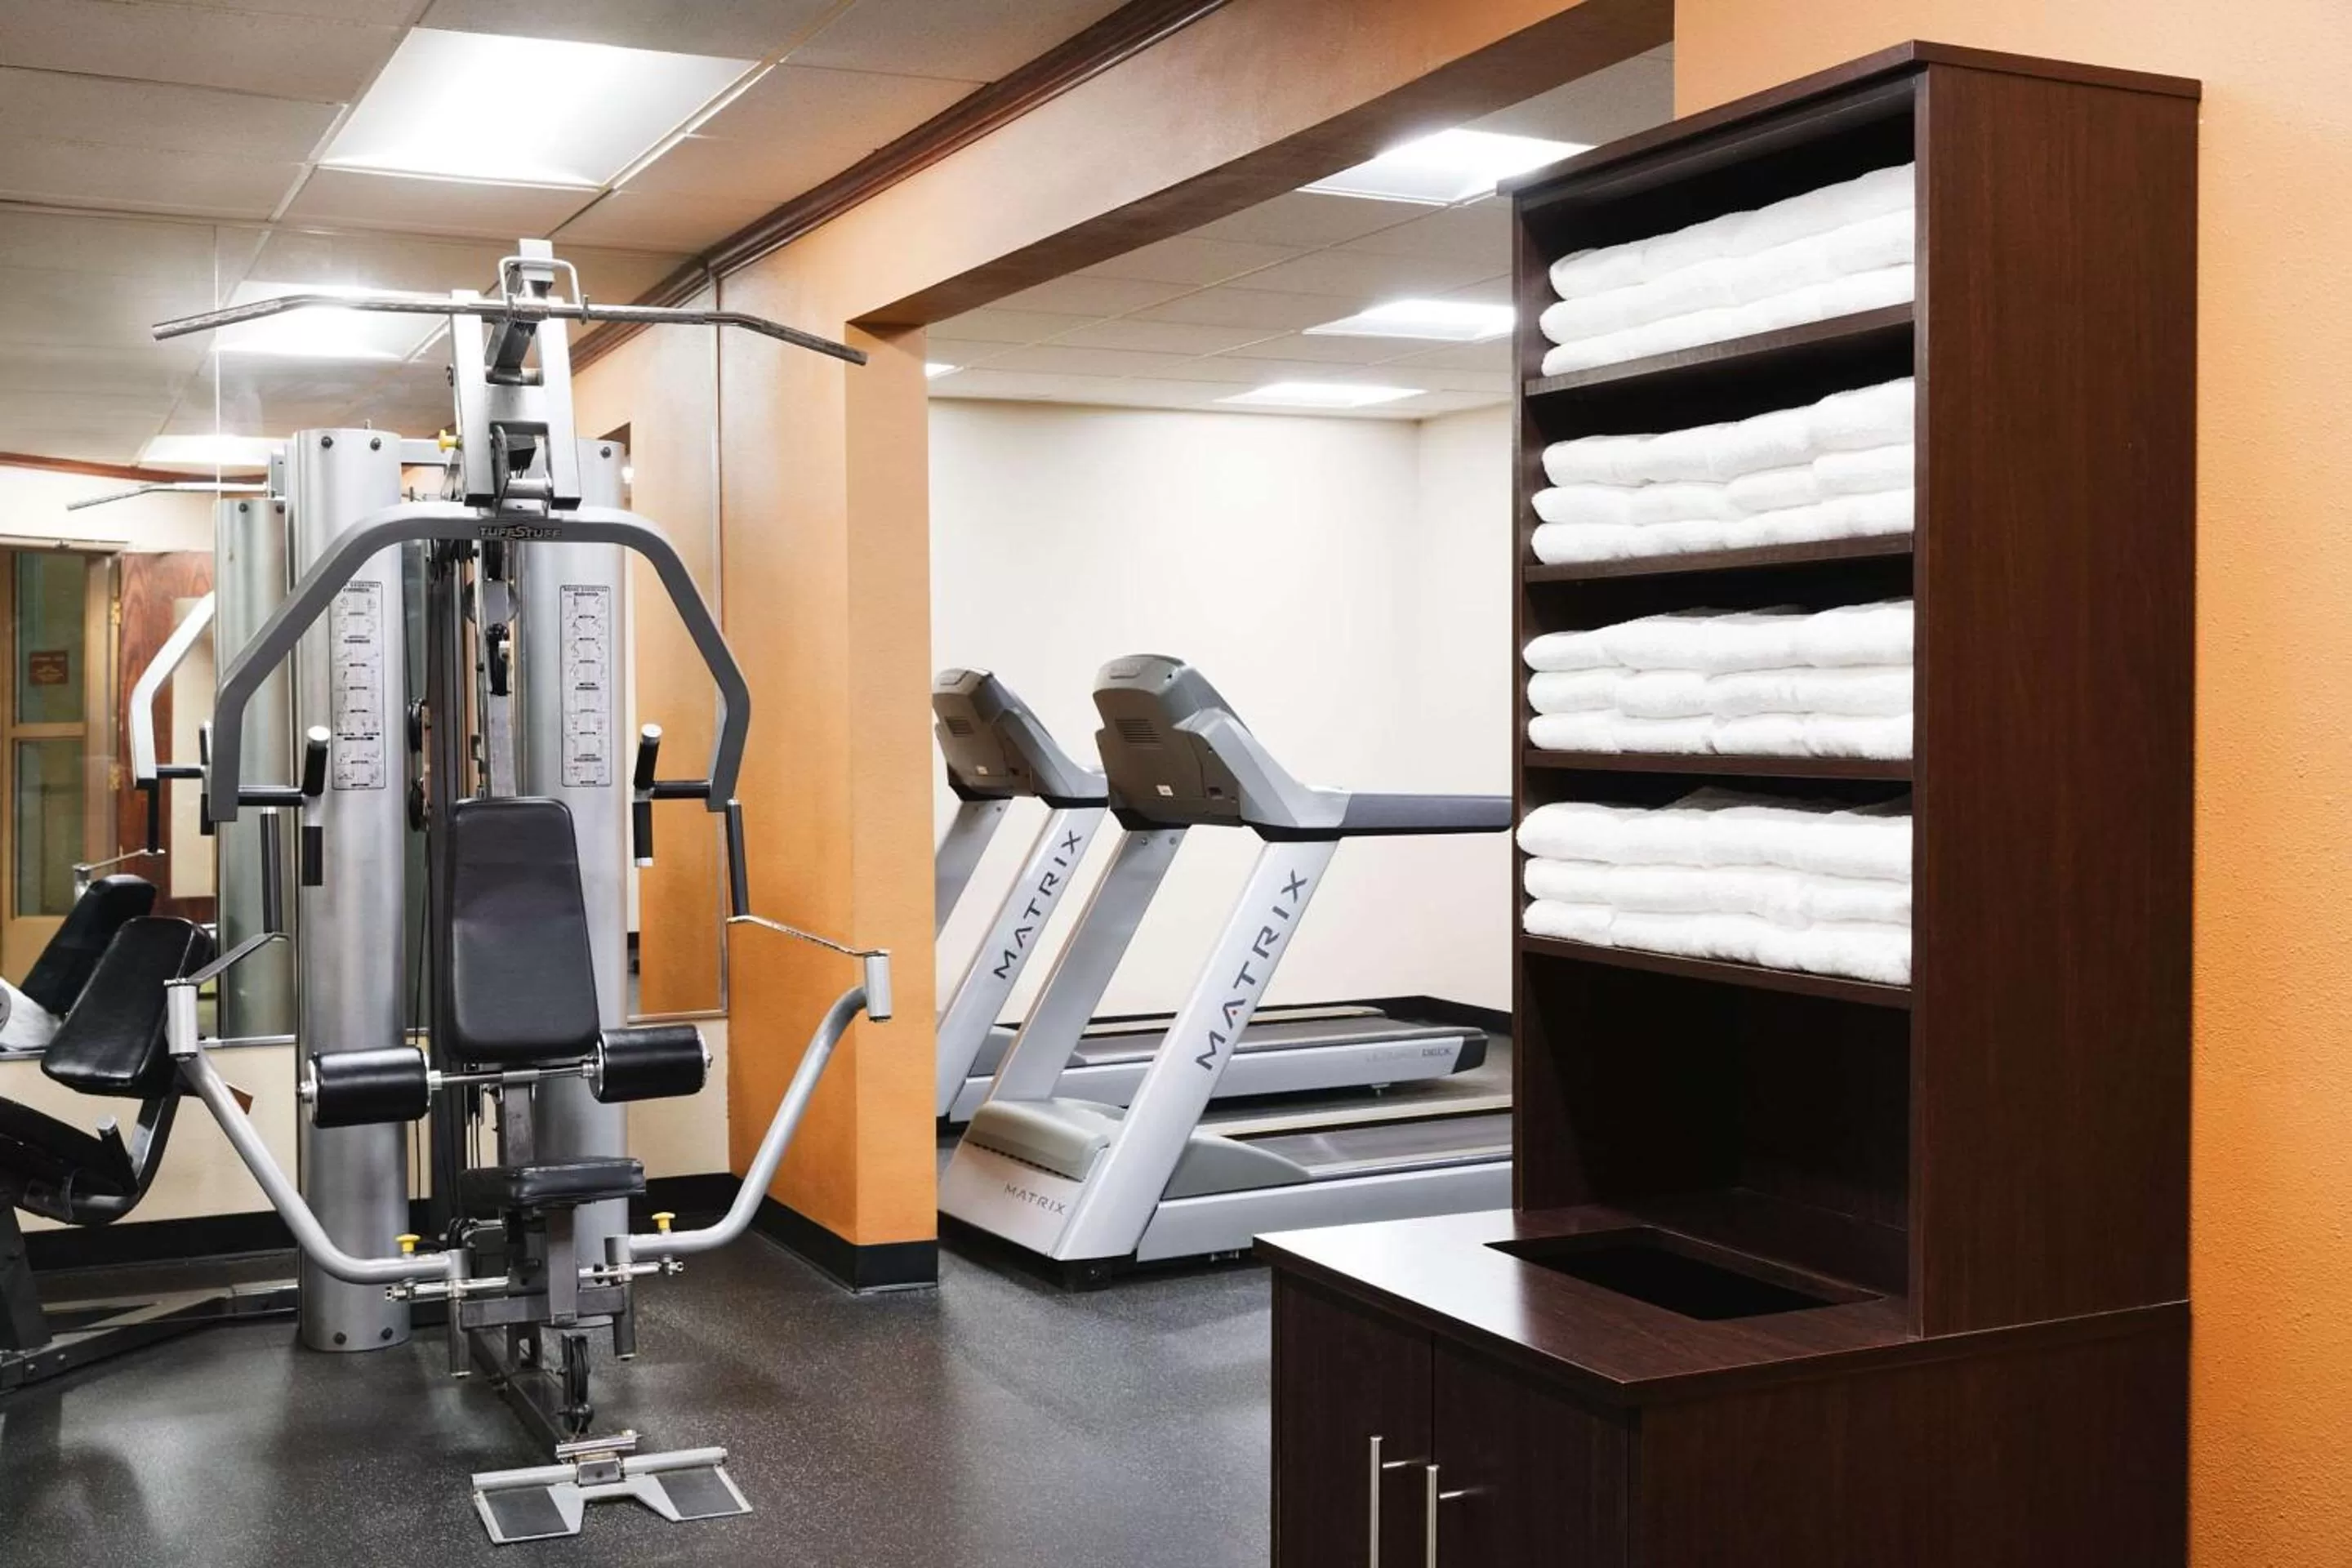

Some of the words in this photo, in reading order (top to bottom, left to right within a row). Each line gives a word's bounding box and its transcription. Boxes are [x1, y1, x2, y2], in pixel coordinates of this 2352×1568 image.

[993, 830, 1082, 980] MATRIX
[1195, 868, 1308, 1071] MATRIX
[1004, 1183, 1066, 1216] MATRIX
